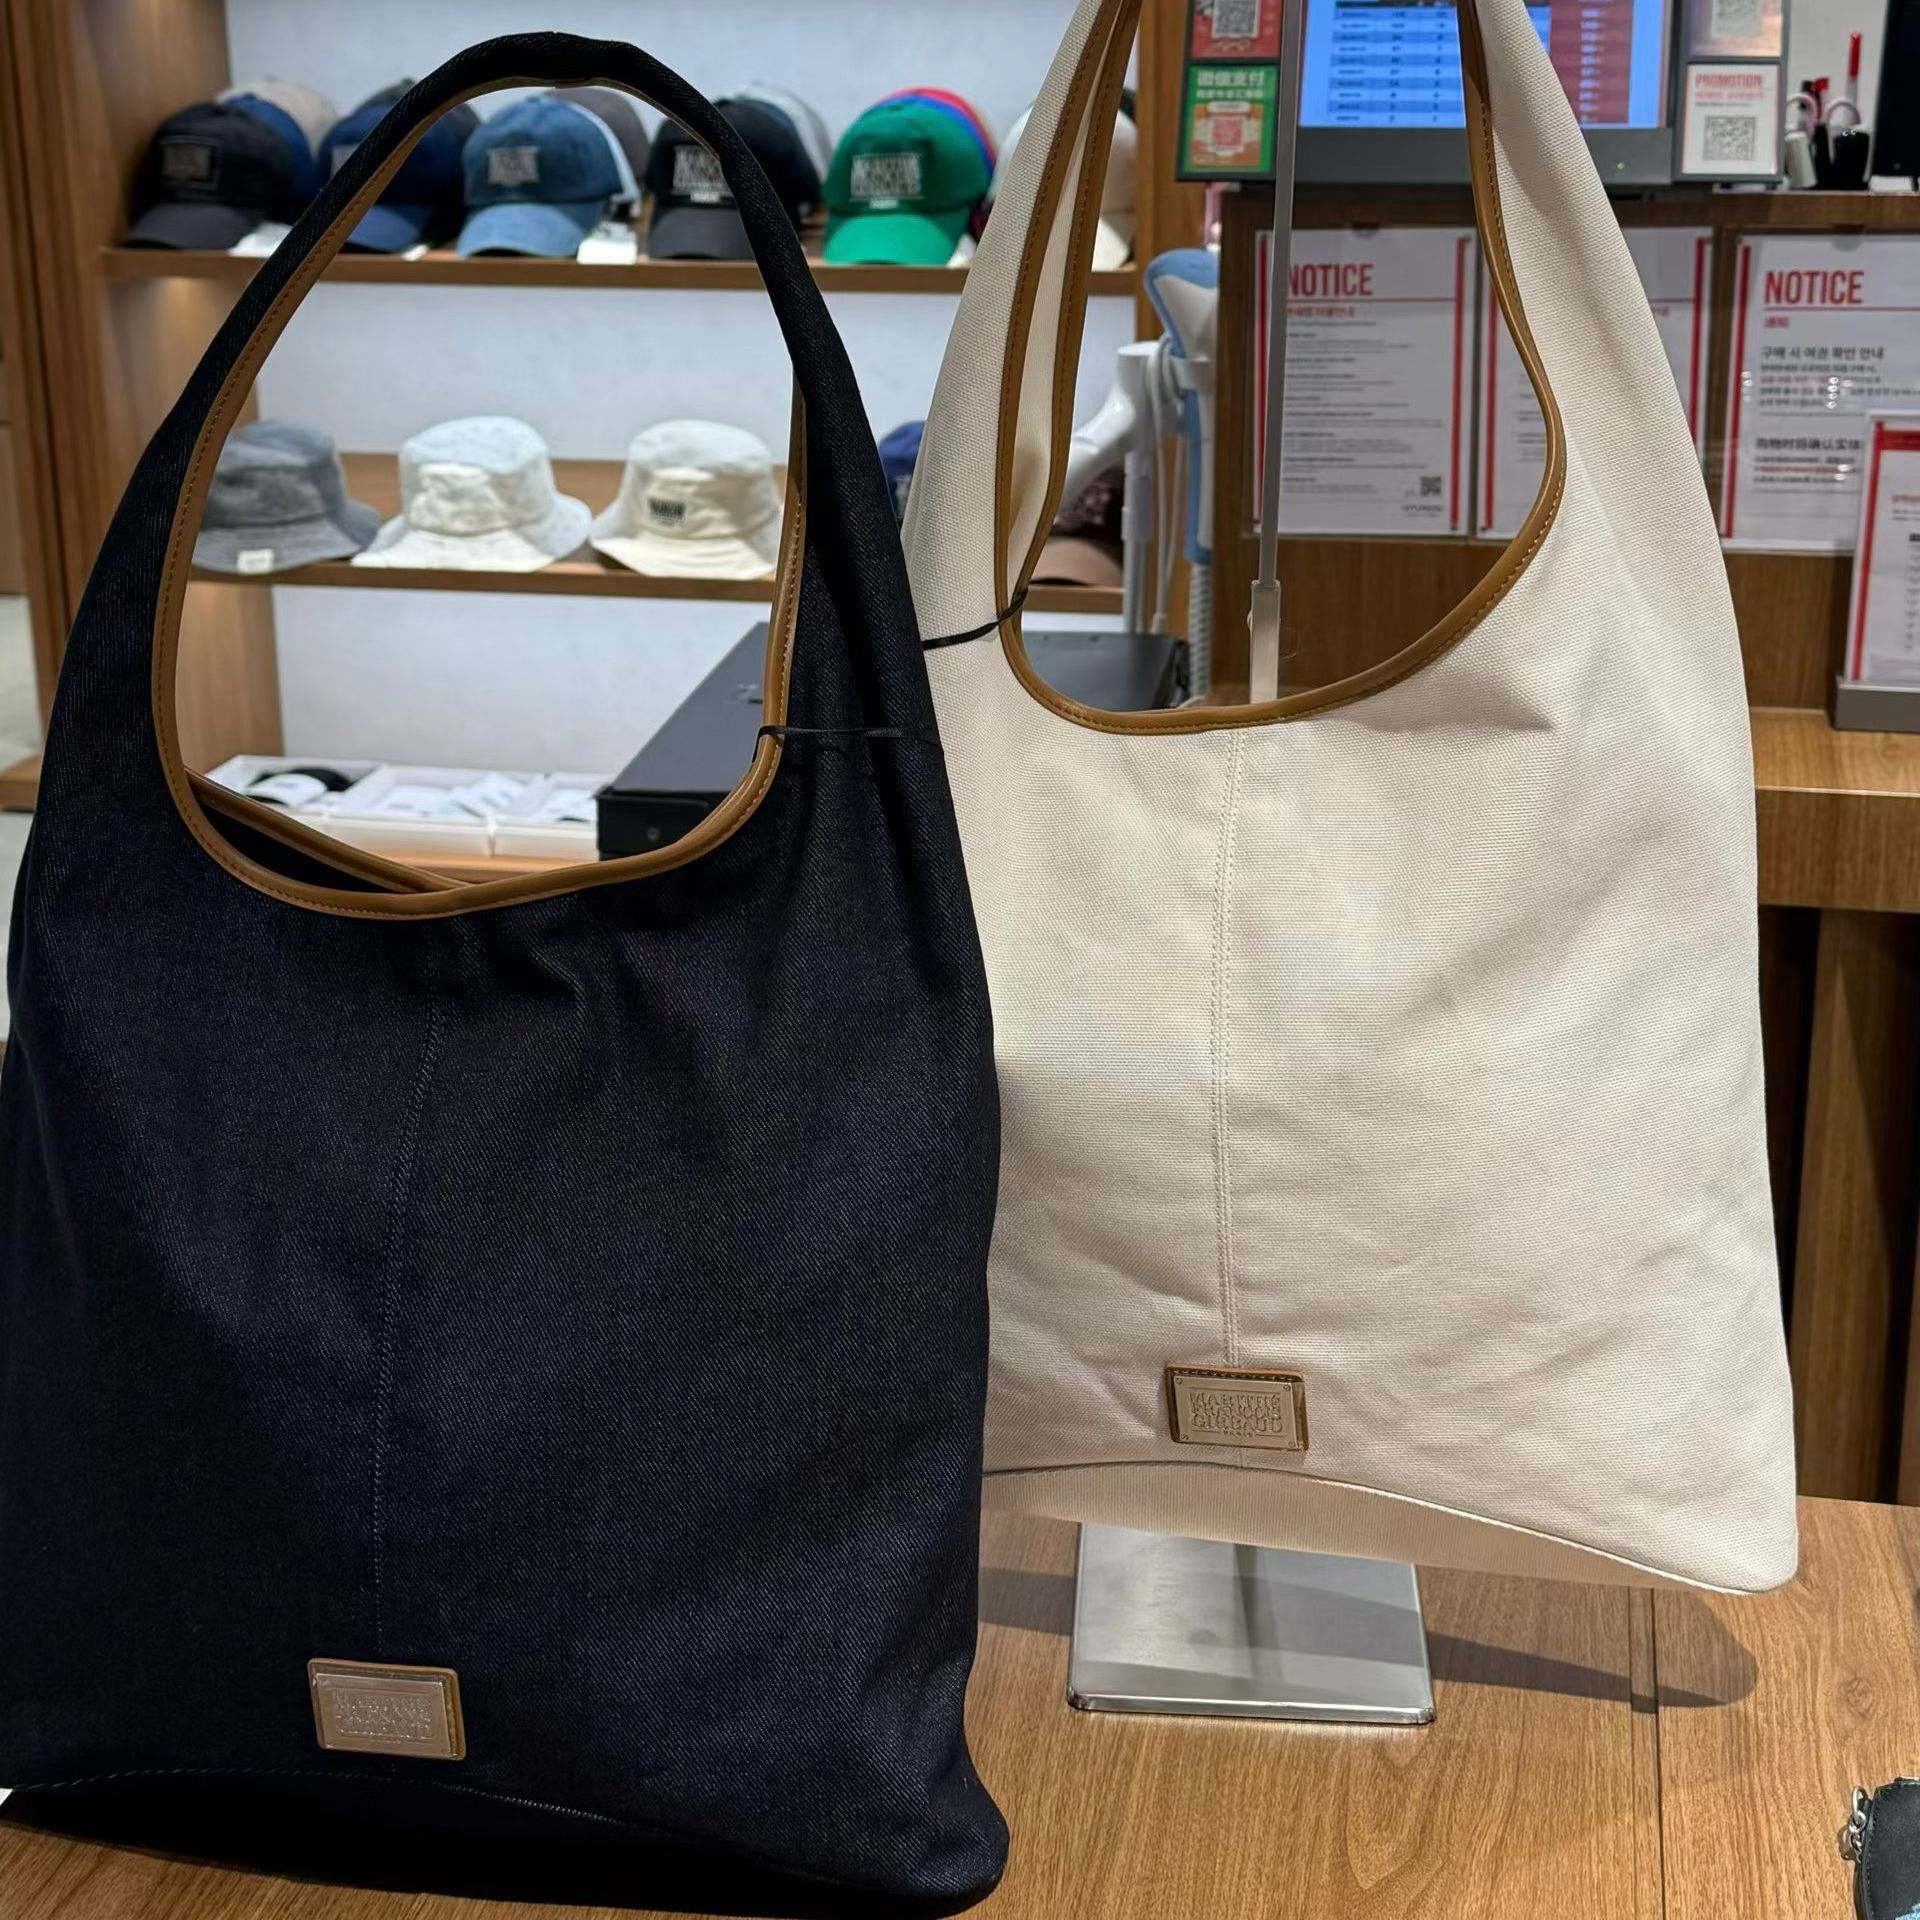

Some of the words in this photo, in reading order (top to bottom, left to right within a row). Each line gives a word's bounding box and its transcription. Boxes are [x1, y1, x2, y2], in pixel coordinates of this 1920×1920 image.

[1696, 73, 1762, 88] PROMOTION
[1289, 263, 1374, 297] NOTICE
[1764, 271, 1865, 304] NOTICE
[1764, 346, 1785, 359] 구매
[1791, 346, 1800, 358] 시
[1859, 346, 1884, 360] 안내
